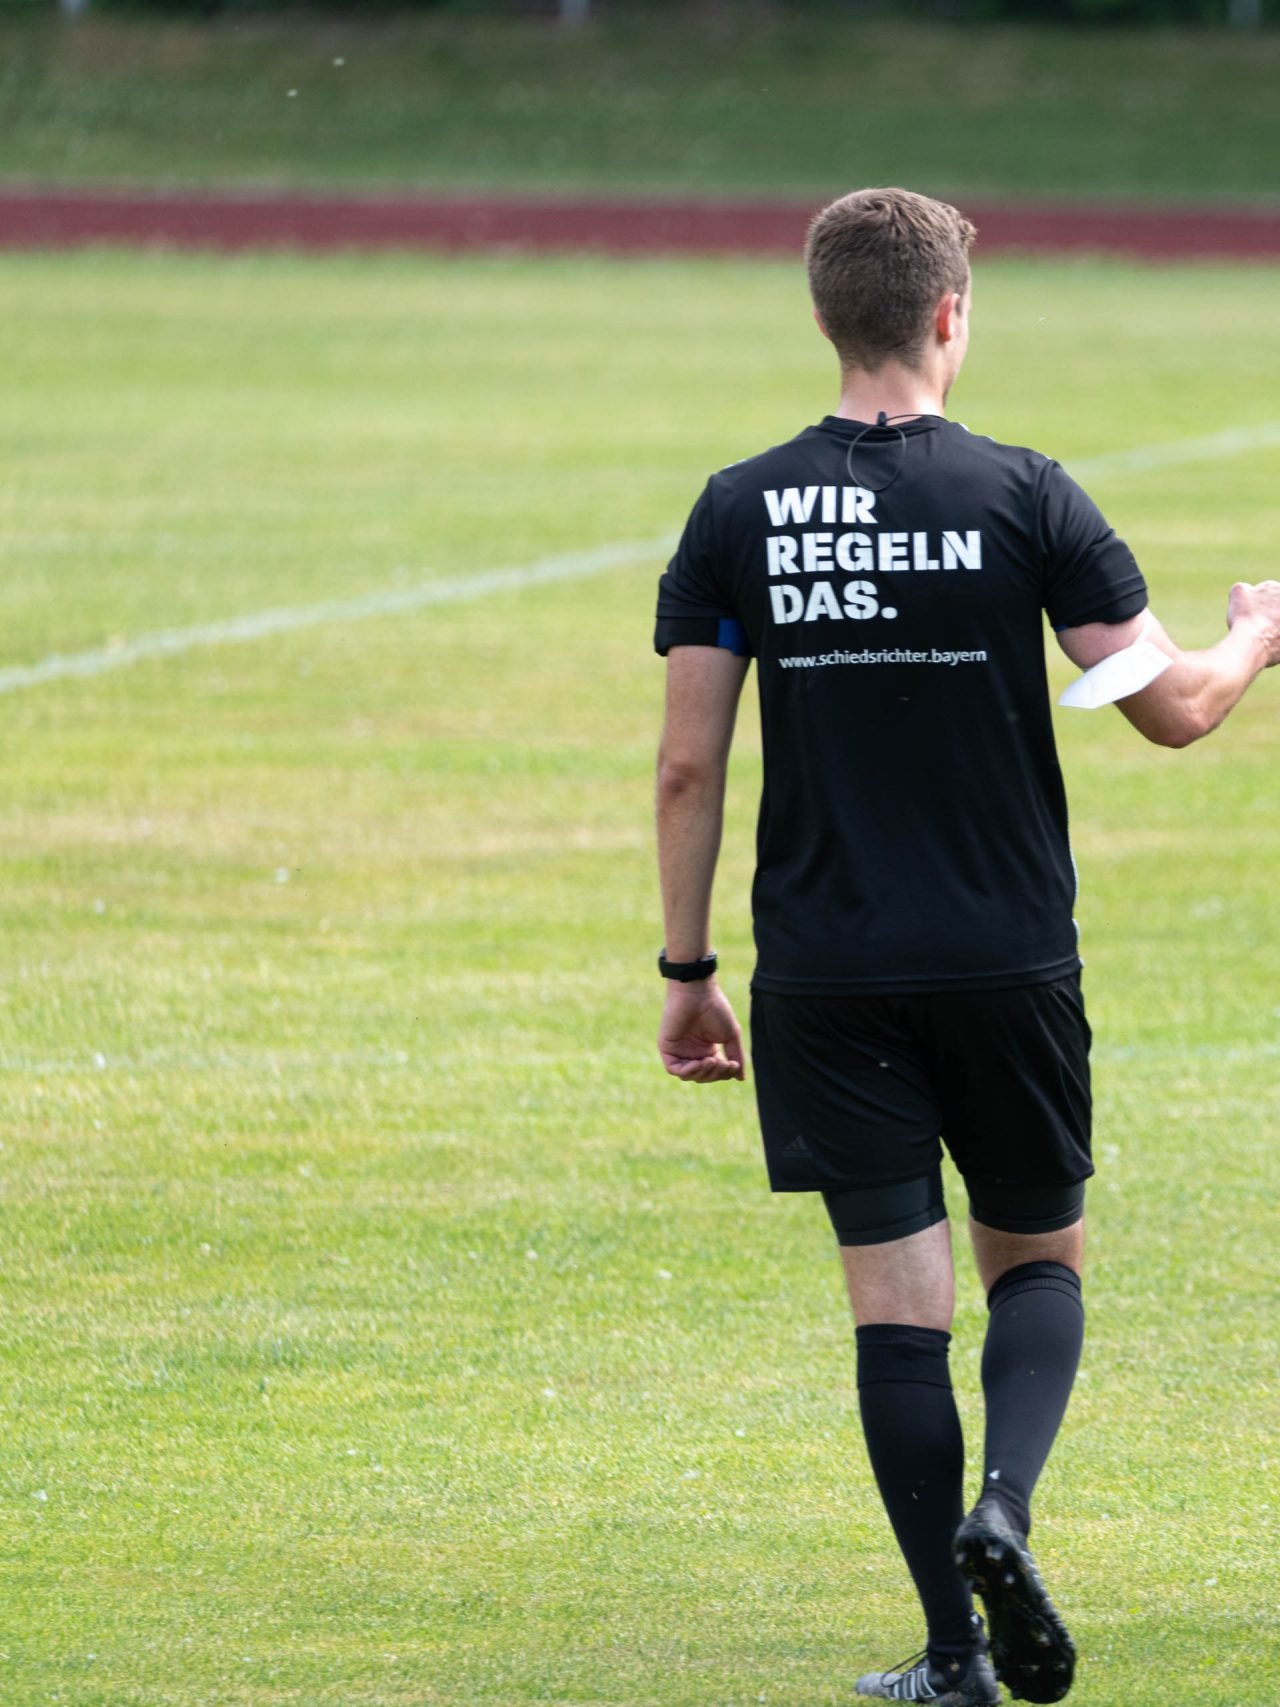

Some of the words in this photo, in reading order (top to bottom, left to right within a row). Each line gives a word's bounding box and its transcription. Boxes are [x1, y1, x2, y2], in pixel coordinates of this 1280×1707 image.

[764, 486, 877, 526] WIR
[766, 530, 982, 576] REGELN
[769, 580, 898, 625] DAS.
[779, 648, 987, 669] www.schiedsrichter.bayern
